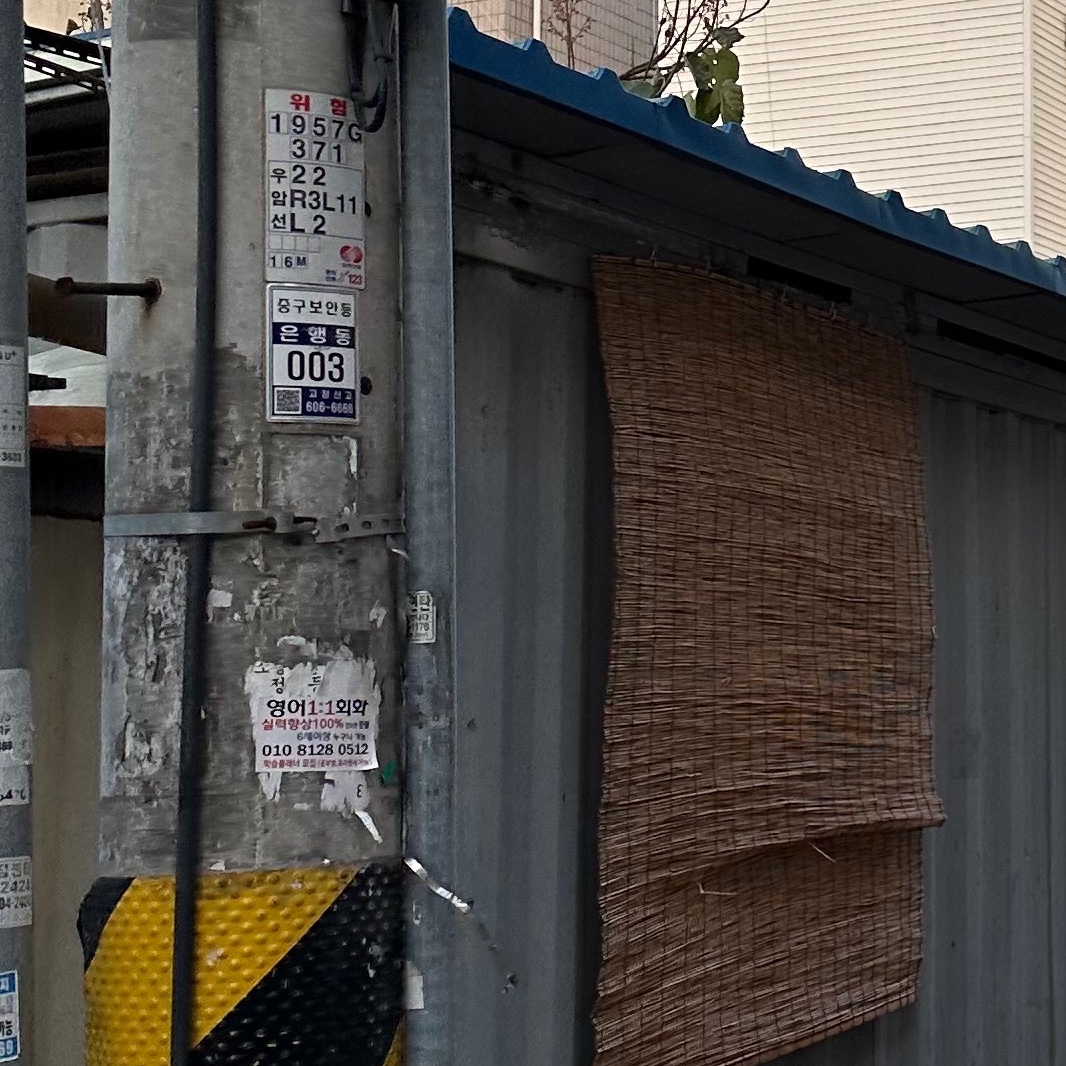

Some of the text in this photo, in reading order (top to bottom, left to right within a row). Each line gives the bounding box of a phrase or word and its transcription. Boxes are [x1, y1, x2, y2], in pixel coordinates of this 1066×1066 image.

[271, 113, 362, 142] 1957G
[292, 138, 342, 163] 371
[280, 324, 351, 346] 은행동
[287, 350, 345, 382] 003
[266, 698, 369, 718] 영어1:1회화
[261, 717, 344, 731] 실력향상100%
[262, 743, 369, 757] 010 8128 0512
